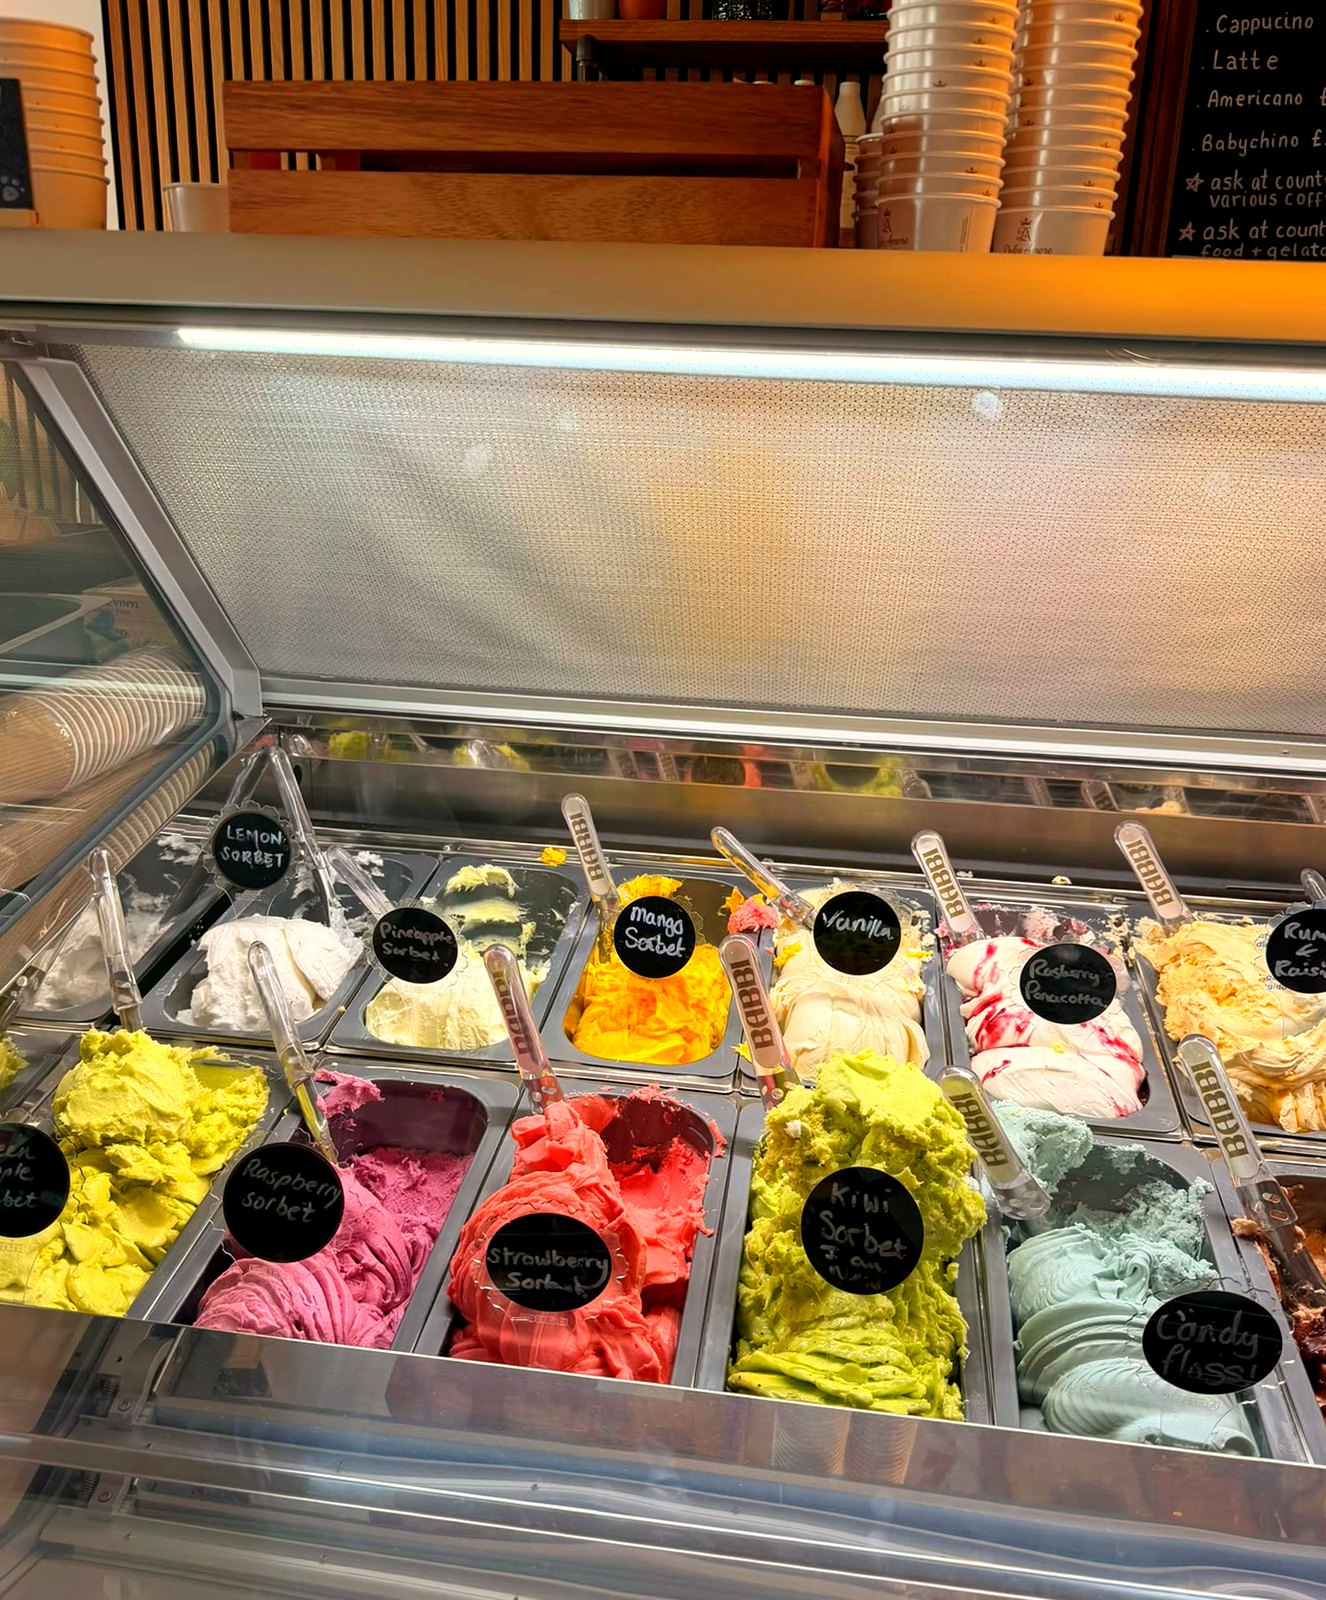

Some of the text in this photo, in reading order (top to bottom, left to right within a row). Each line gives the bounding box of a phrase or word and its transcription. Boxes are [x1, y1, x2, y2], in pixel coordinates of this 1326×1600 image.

[1215, 11, 1314, 36] Cappucino
[1213, 49, 1279, 70] Latte
[1207, 89, 1303, 108] Americano
[1201, 130, 1299, 157] Babychino
[1210, 168, 1326, 191] ask at count
[1209, 190, 1326, 208] various coff
[1202, 217, 1241, 241] ask
[1249, 219, 1269, 239] at
[226, 824, 283, 850] LEMON
[568, 811, 605, 882] BABBI
[220, 846, 284, 868] SORBET
[923, 847, 963, 919] BABBI
[1125, 838, 1173, 907] BABBI
[624, 926, 686, 957] Sorbet
[731, 958, 775, 1050] BABBI
[1194, 1061, 1249, 1158] BABBI
[949, 1091, 1009, 1167] BABBI
[242, 1158, 341, 1210] Raspberry
